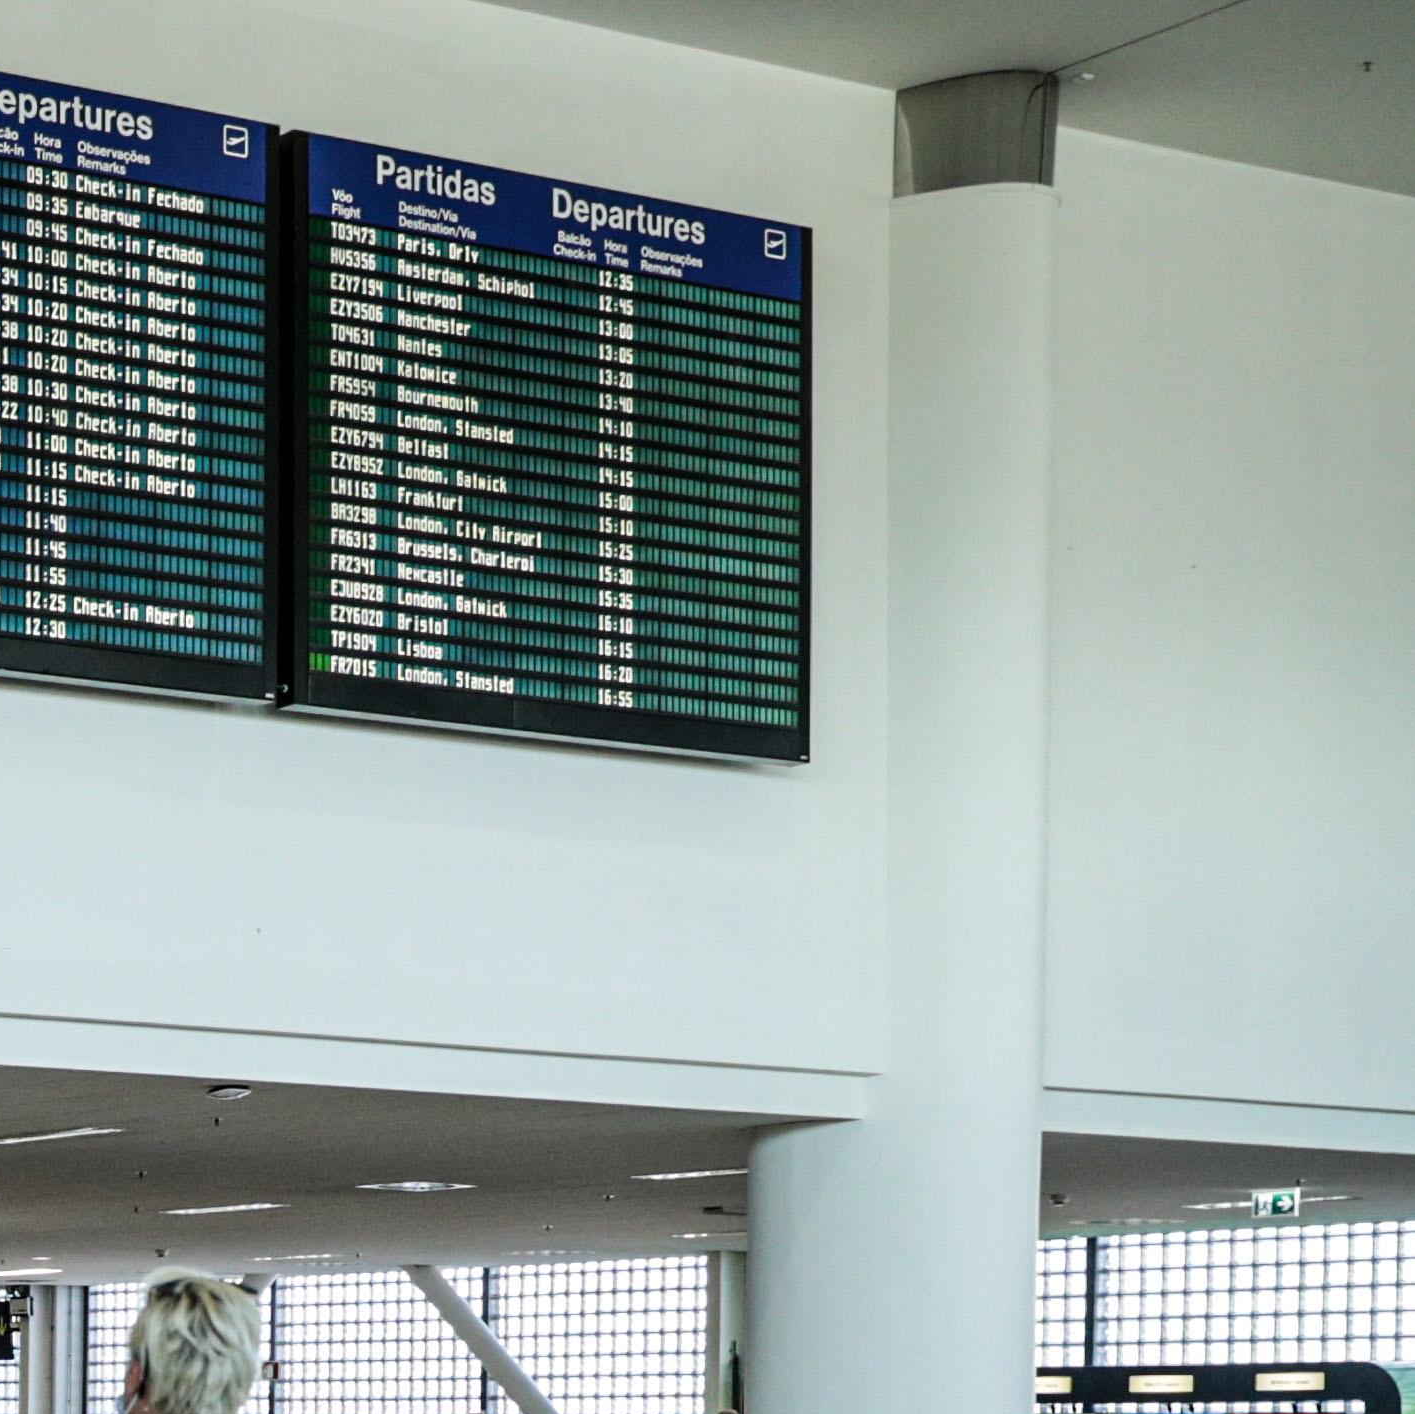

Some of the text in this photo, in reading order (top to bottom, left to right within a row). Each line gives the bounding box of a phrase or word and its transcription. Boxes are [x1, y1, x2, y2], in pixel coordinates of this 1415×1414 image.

[34, 132, 62, 149] Hora
[77, 141, 151, 166] Observações
[35, 147, 63, 164] Time
[77, 156, 126, 176] Remarks
[27, 166, 67, 189] 09:30
[76, 175, 140, 202] Check-in
[148, 188, 204, 213] Fechado
[27, 193, 67, 215] 09:35
[76, 201, 140, 228] Embarque
[376, 154, 706, 245] Partidas Departures
[27, 219, 67, 242] 09:45
[76, 227, 140, 254] Check-in
[148, 240, 203, 265] Fechado
[331, 203, 683, 278] Flight Destination/Via Check-in Time Remarks
[398, 201, 459, 223] Destino/Via
[604, 239, 628, 254] Hora
[28, 246, 67, 268] 10:00
[76, 254, 140, 280] Check-in
[148, 266, 195, 289] Aberto
[28, 272, 67, 294] 10:15
[76, 280, 140, 306] Check-in
[148, 292, 195, 315] Aberto
[398, 284, 462, 310] Liverpool
[599, 320, 633, 340] 13:00
[28, 298, 67, 320] 10:20
[76, 306, 140, 332] Check-in
[148, 318, 195, 341] Aberto
[28, 325, 67, 347] 10:20
[76, 332, 140, 358] Check-in
[148, 344, 195, 367] Aberto
[28, 351, 67, 373] 10:20
[76, 359, 140, 384] Check-in
[148, 370, 195, 393] Aberto
[398, 360, 456, 384] Katowice
[600, 393, 633, 413] 13:40
[28, 379, 67, 400] 10:30
[76, 386, 140, 411] Check-in
[148, 397, 196, 420] Aberto
[27, 432, 67, 453] 11:00
[75, 439, 140, 464] Check-in
[148, 449, 195, 472] Aberto
[398, 436, 448, 459] Belfast
[599, 468, 633, 487] 14:15
[27, 458, 67, 480] 11:15
[75, 465, 139, 490] Check-in
[147, 475, 195, 498] Aberto
[27, 485, 67, 506] 11:15
[27, 511, 66, 532] 11:40
[398, 487, 463, 511] Frankfurt
[600, 517, 633, 536] 15:10
[471, 547, 534, 572] Charleroi
[599, 566, 633, 585] 15:30
[26, 591, 66, 612] 12:25
[74, 597, 138, 621] Check-in
[146, 605, 195, 628] Aberto
[26, 617, 66, 639] 12:30
[398, 613, 448, 635] Bristol
[599, 639, 633, 658] 16:15
[456, 671, 514, 694] Stansted
[599, 688, 633, 708] 16:55
